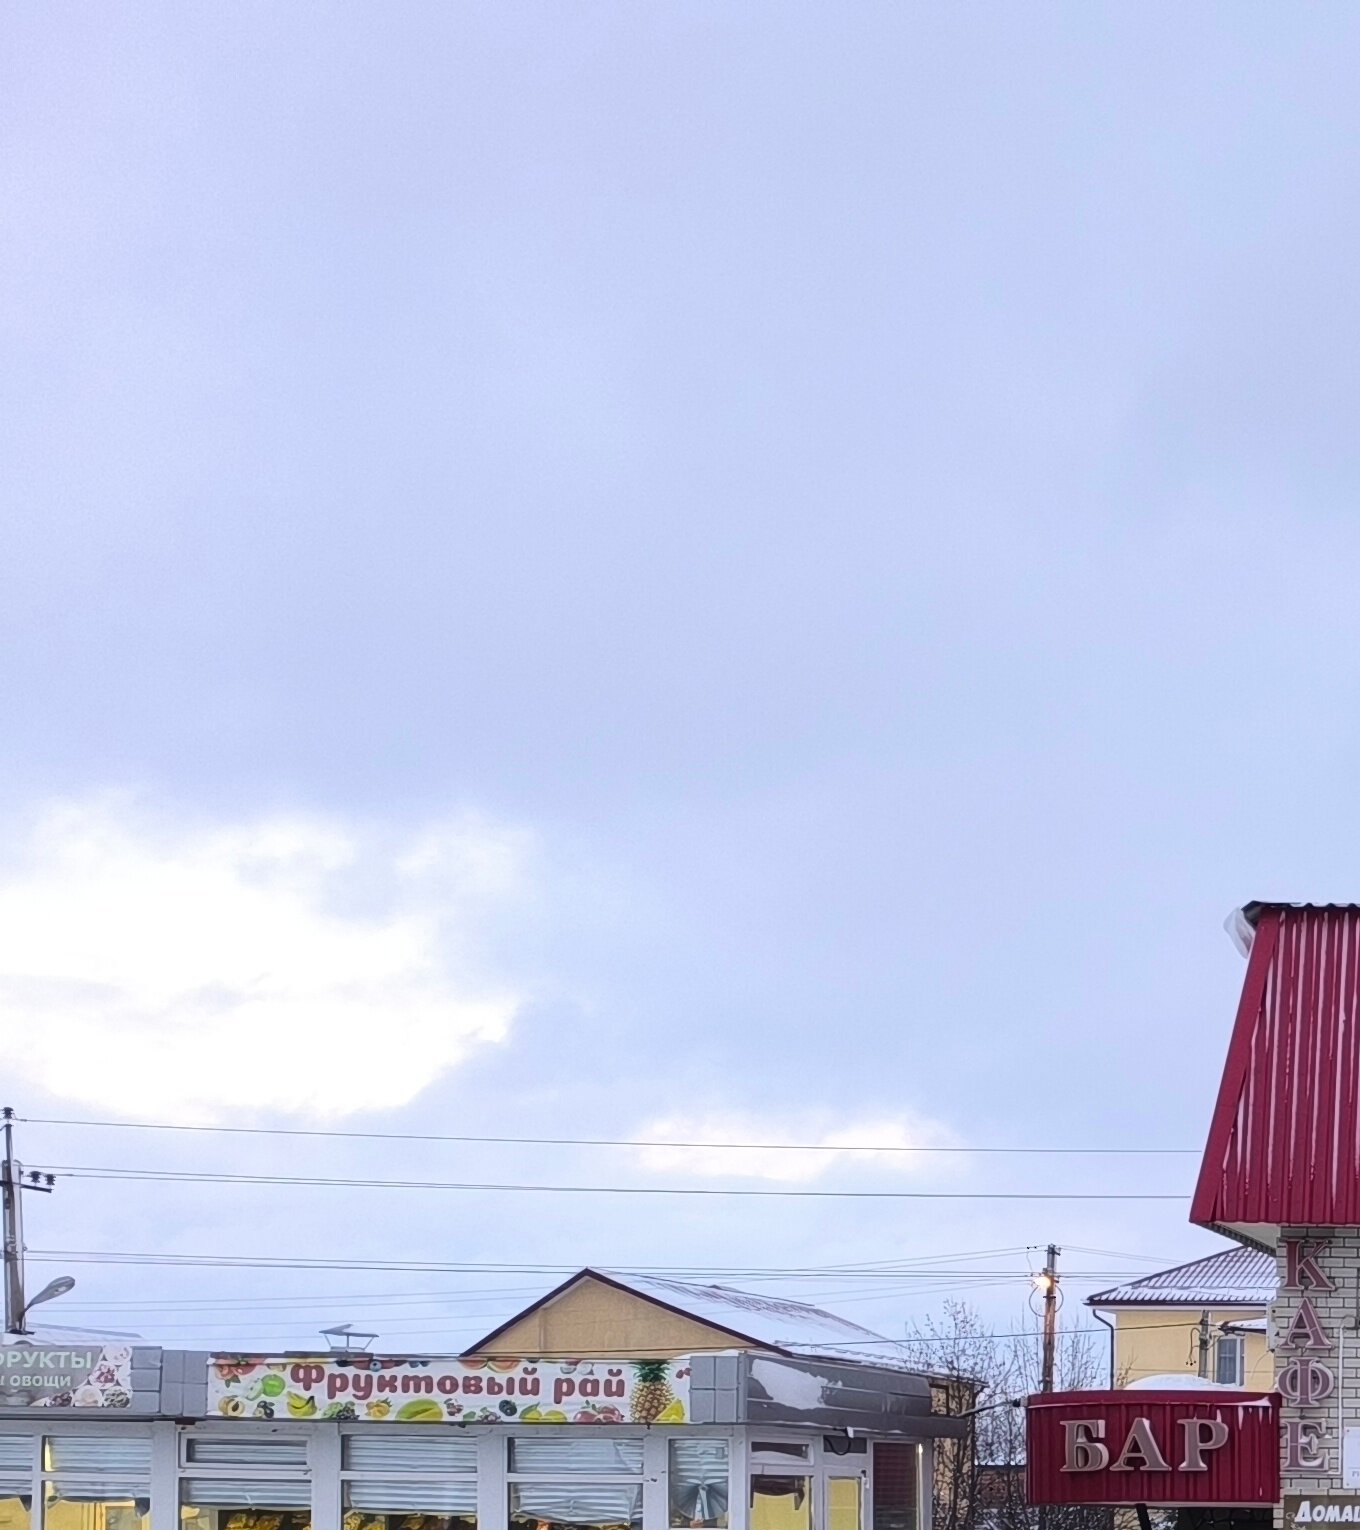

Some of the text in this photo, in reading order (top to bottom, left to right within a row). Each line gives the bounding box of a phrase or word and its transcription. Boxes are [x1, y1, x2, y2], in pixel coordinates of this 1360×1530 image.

[1276, 1237, 1336, 1473] КАФЕ
[290, 1363, 626, 1404] Фруктовый рай
[1059, 1417, 1230, 1472] БАР
